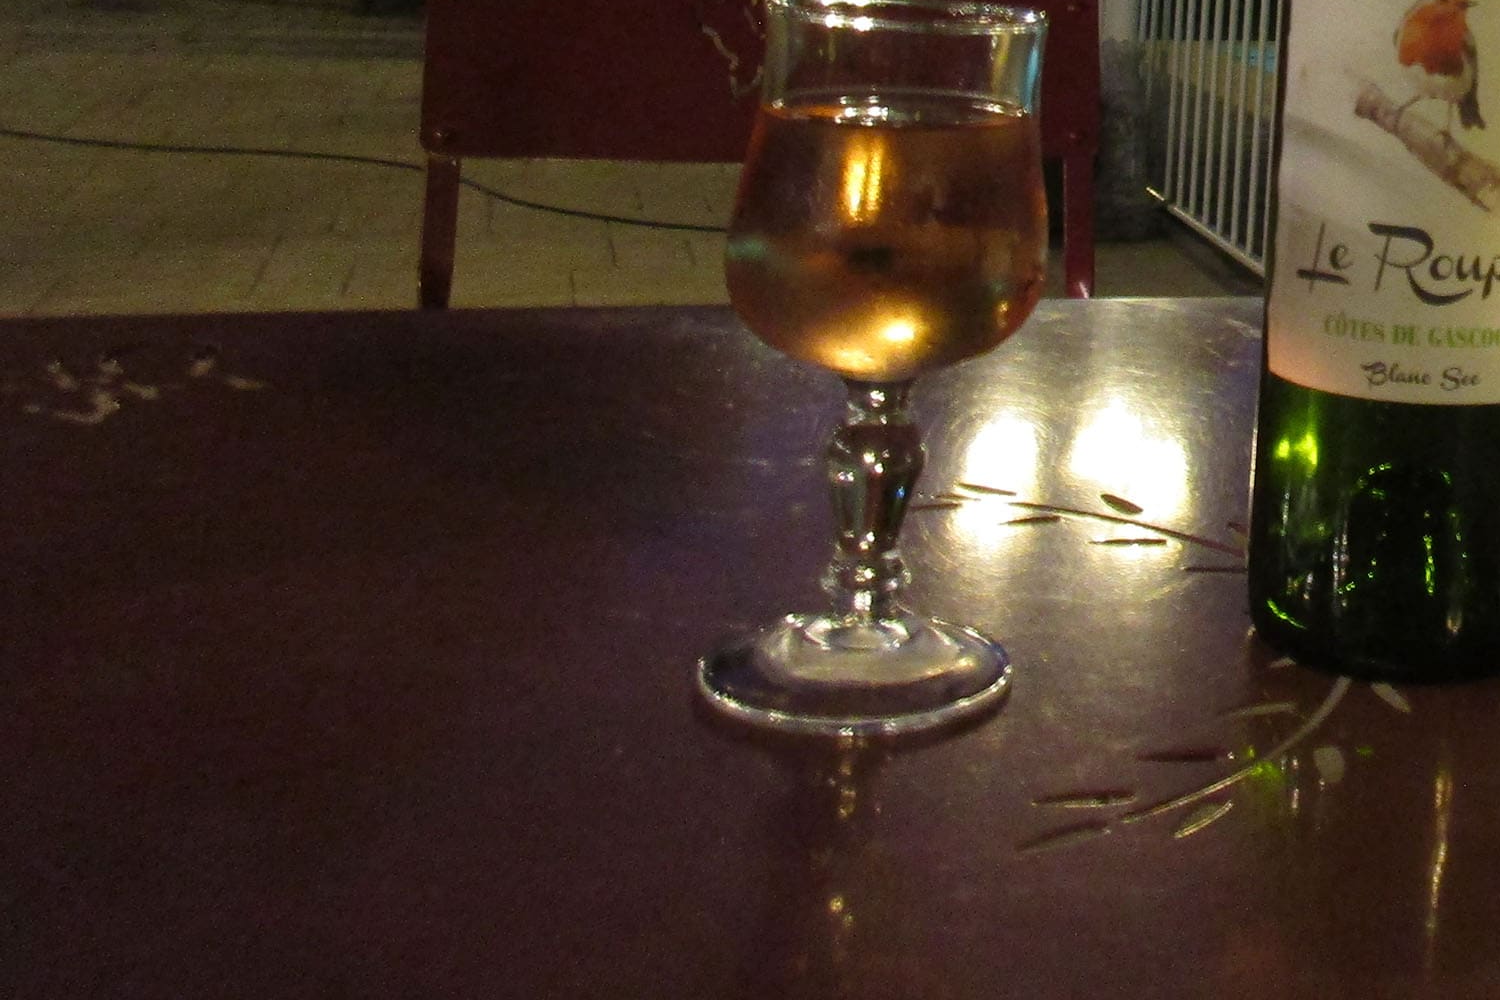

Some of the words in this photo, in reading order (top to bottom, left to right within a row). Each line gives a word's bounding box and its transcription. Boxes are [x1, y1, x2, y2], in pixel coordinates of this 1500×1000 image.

[1296, 221, 1354, 293] Le
[1391, 323, 1420, 346] DE
[1361, 360, 1432, 389] Blanc
[1439, 366, 1483, 391] Sec
